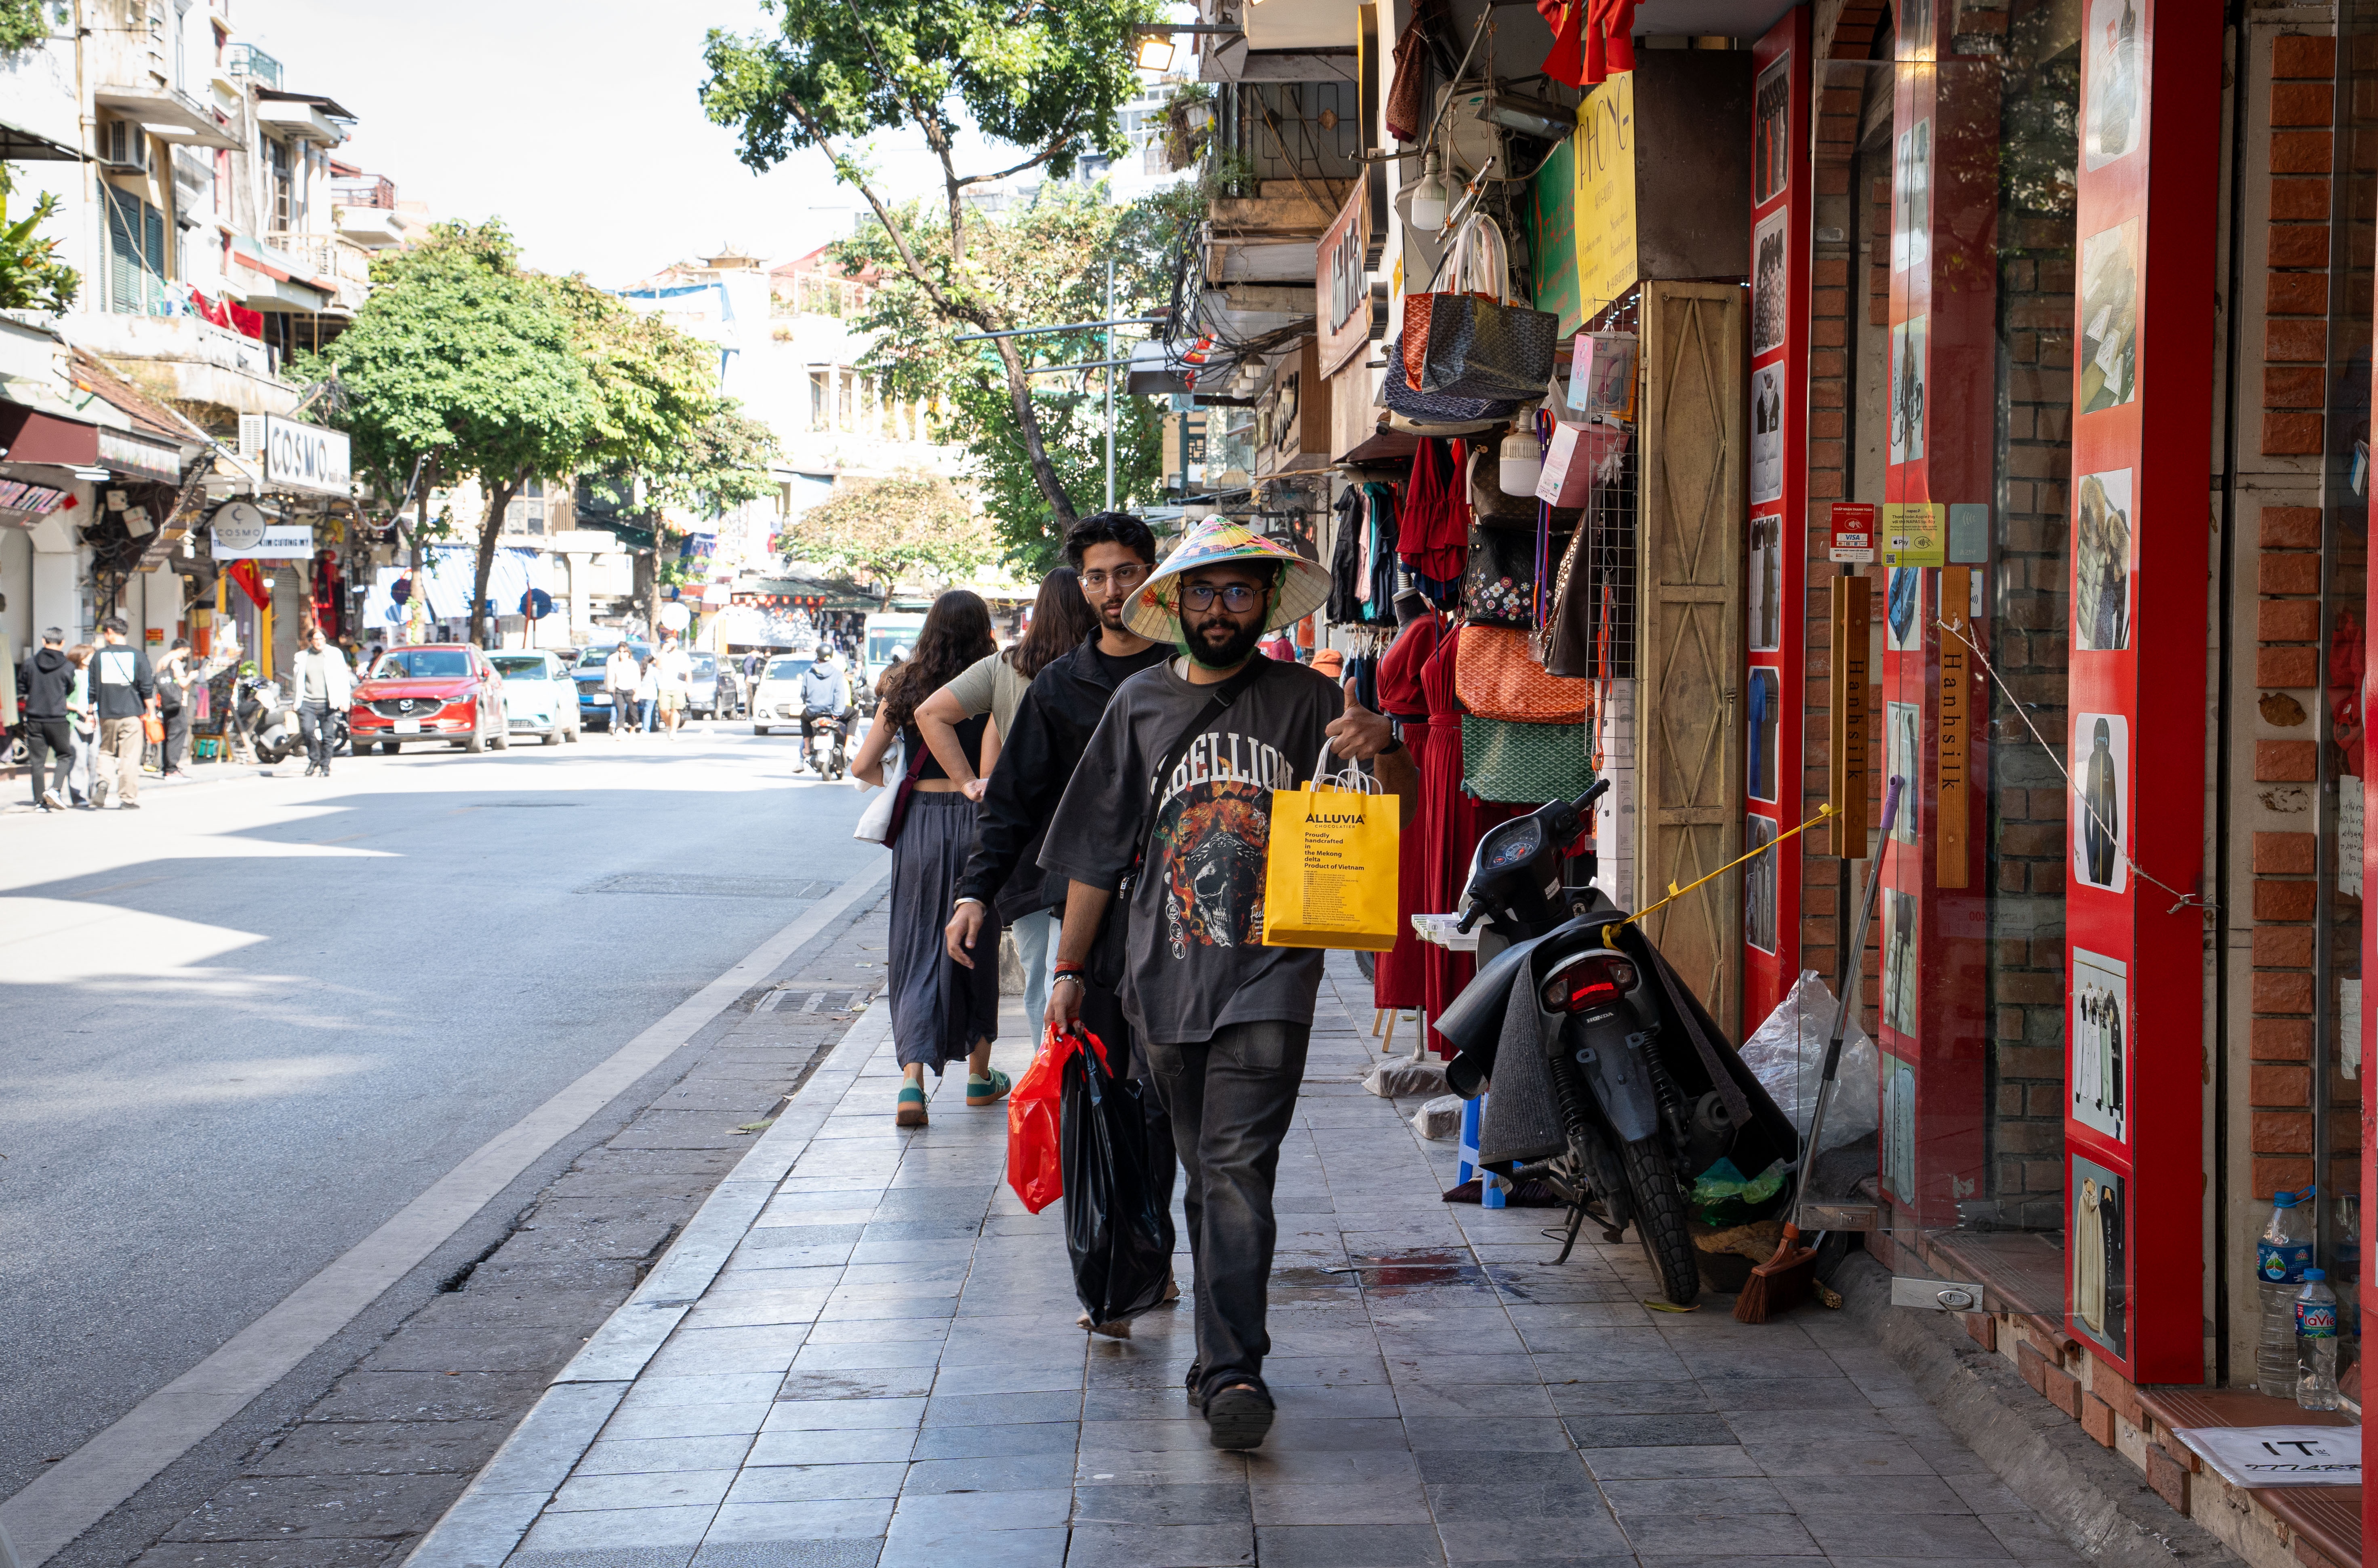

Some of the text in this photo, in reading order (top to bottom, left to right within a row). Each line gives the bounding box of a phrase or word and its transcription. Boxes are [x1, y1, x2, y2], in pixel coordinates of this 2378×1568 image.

[1580, 76, 1629, 191] PHONG
[272, 426, 326, 483] COSMO
[217, 528, 261, 537] COSMO
[1848, 660, 1865, 781] Hanhsilk
[1942, 653, 1962, 791] Hanhsilk
[1586, 1012, 1614, 1023] HONDA
[2304, 1314, 2335, 1326] laVie
[2261, 1441, 2319, 1456] IT
